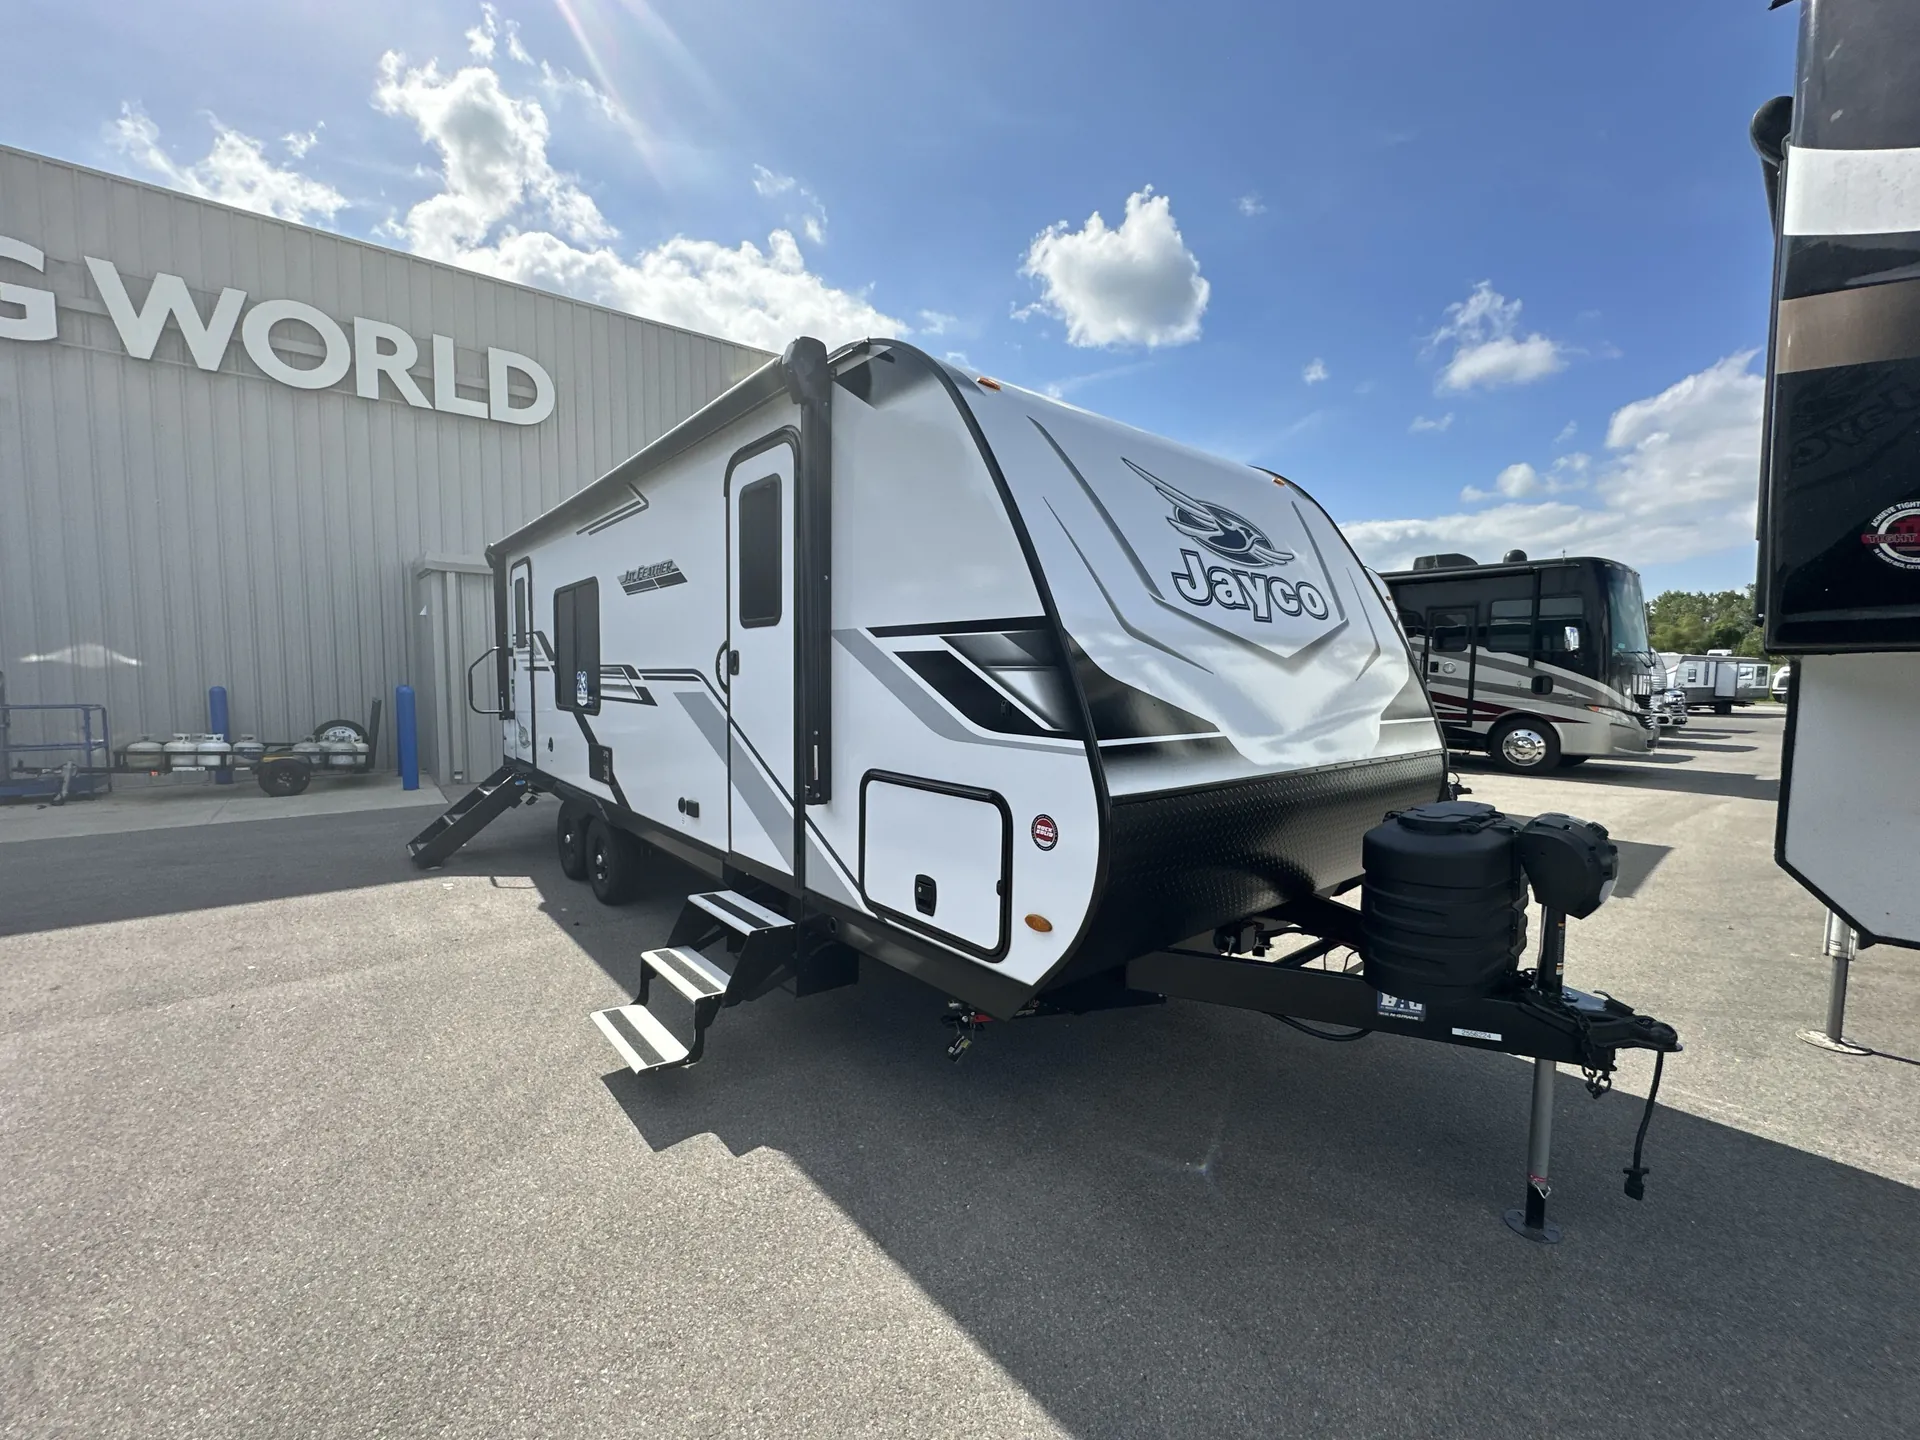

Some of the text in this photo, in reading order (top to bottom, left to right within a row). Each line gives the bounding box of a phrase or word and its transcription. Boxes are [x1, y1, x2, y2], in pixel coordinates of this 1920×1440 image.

[84, 256, 556, 426] WORLD
[1871, 506, 1897, 527] ACHIEVE
[1866, 533, 1918, 544] TIGHT
[637, 560, 673, 581] FEATHER
[1171, 548, 1328, 623] Jayco
